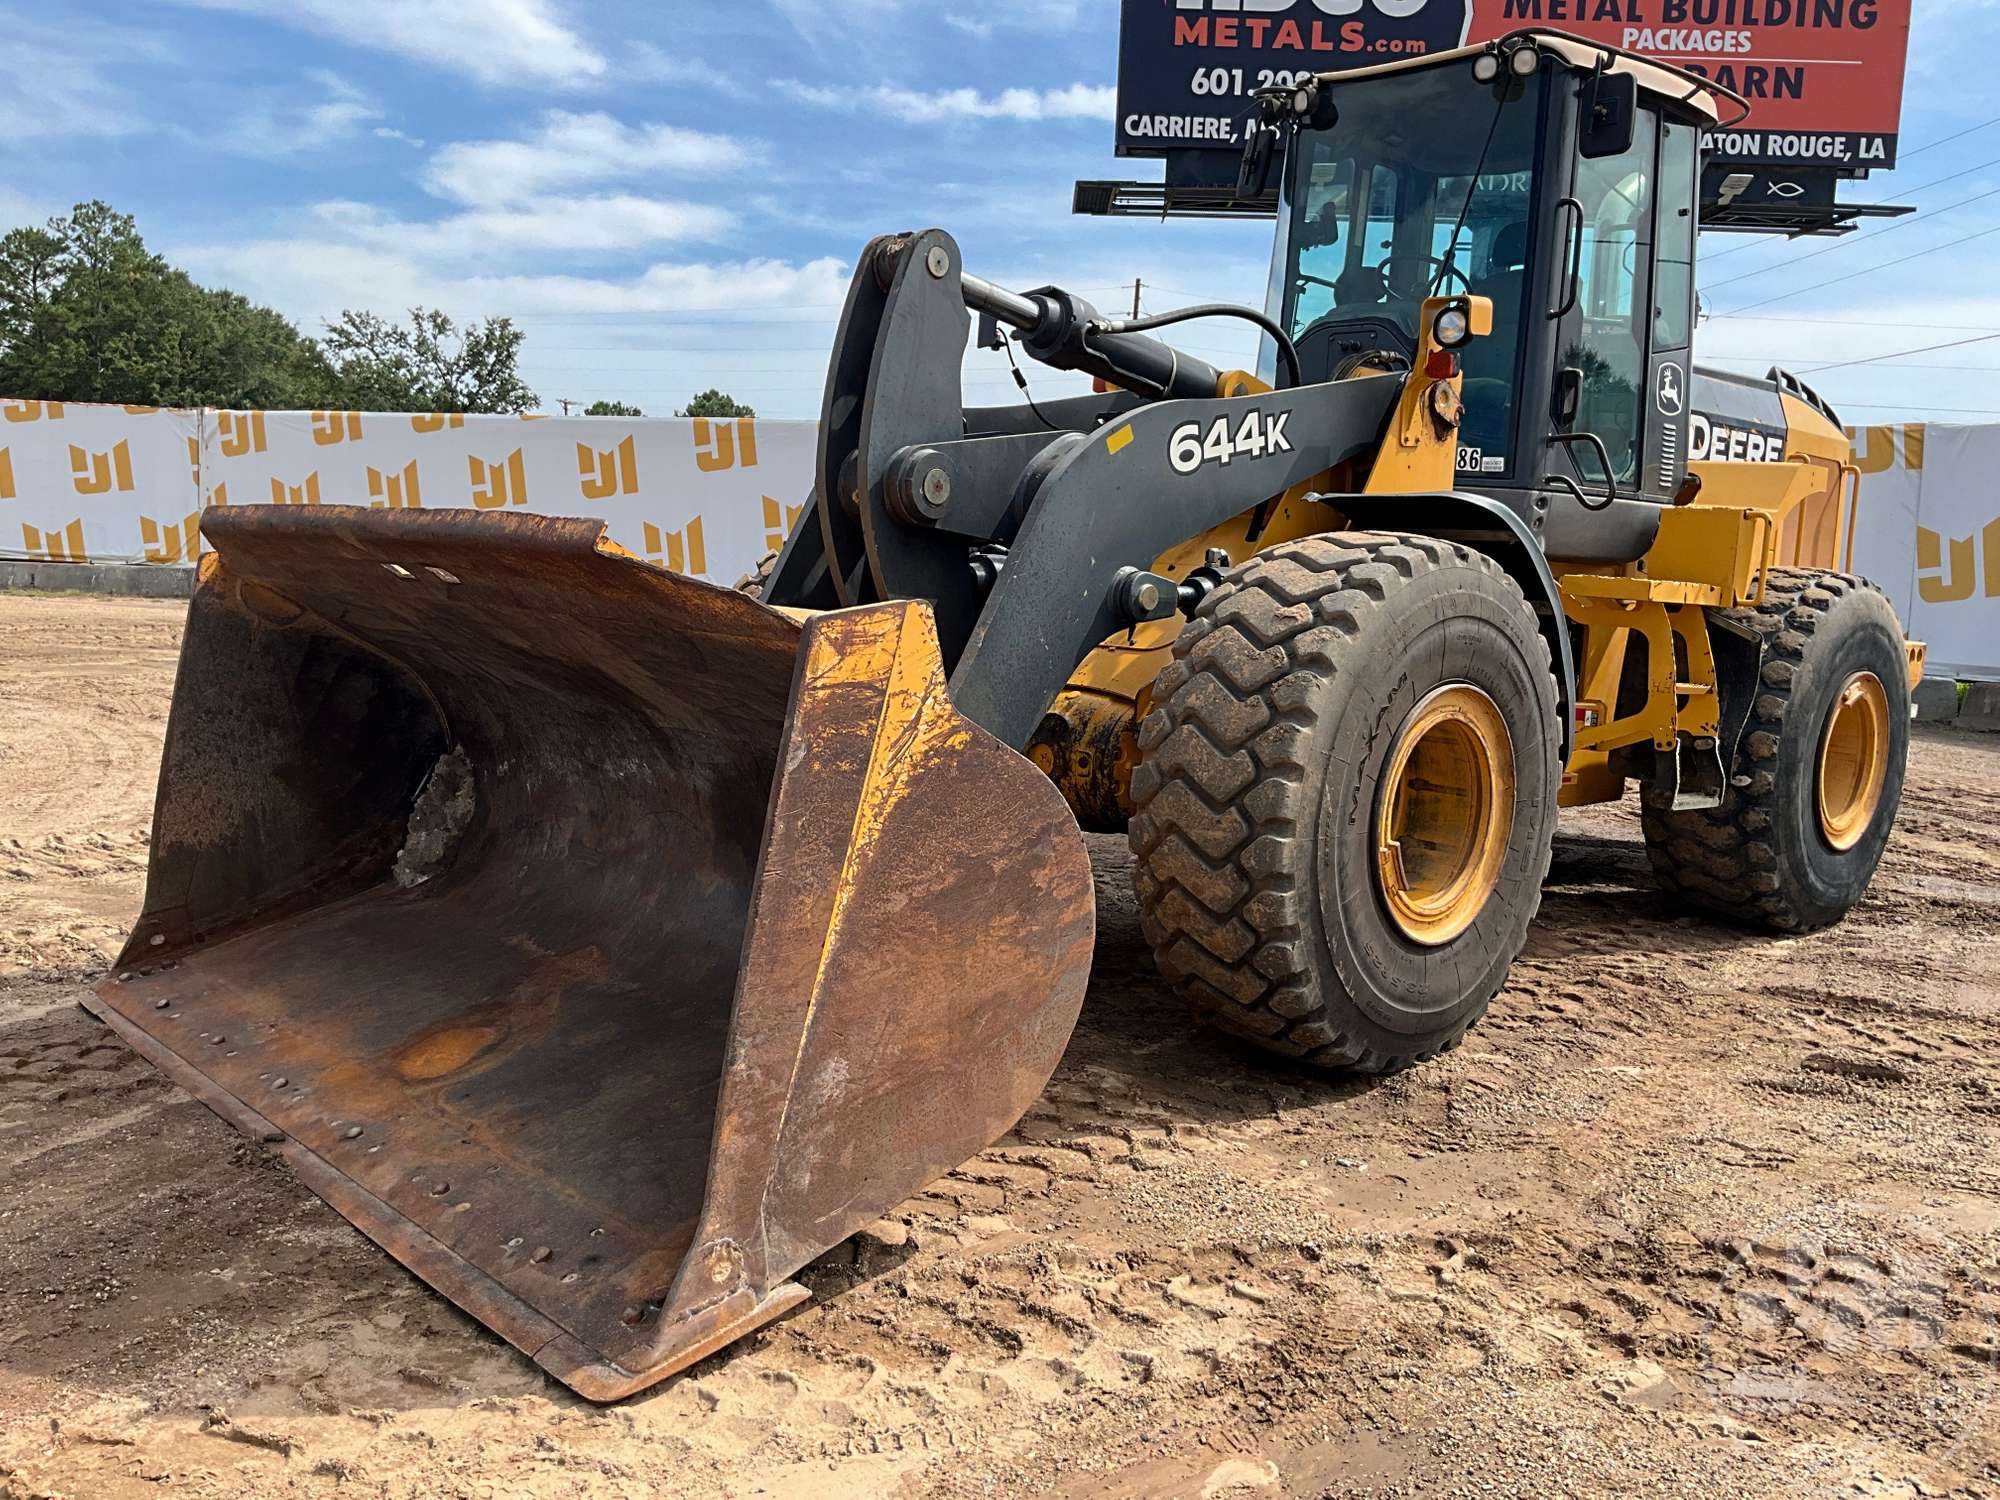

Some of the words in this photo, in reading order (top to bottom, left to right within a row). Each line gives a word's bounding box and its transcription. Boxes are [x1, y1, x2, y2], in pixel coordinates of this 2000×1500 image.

[1503, 0, 1643, 23] METAL
[1662, 0, 1879, 29] BUILDING
[1174, 15, 1426, 53] METALS.com
[1622, 27, 1752, 53] PACKAGES
[1124, 114, 1239, 144] CARRIERE,
[1700, 132, 1761, 155] ATON
[1767, 135, 1852, 162] ROUGE,
[1859, 137, 1886, 159] LA
[1167, 407, 1296, 476] 644K
[1687, 411, 1784, 463] DEERE
[1457, 448, 1480, 470] 86
